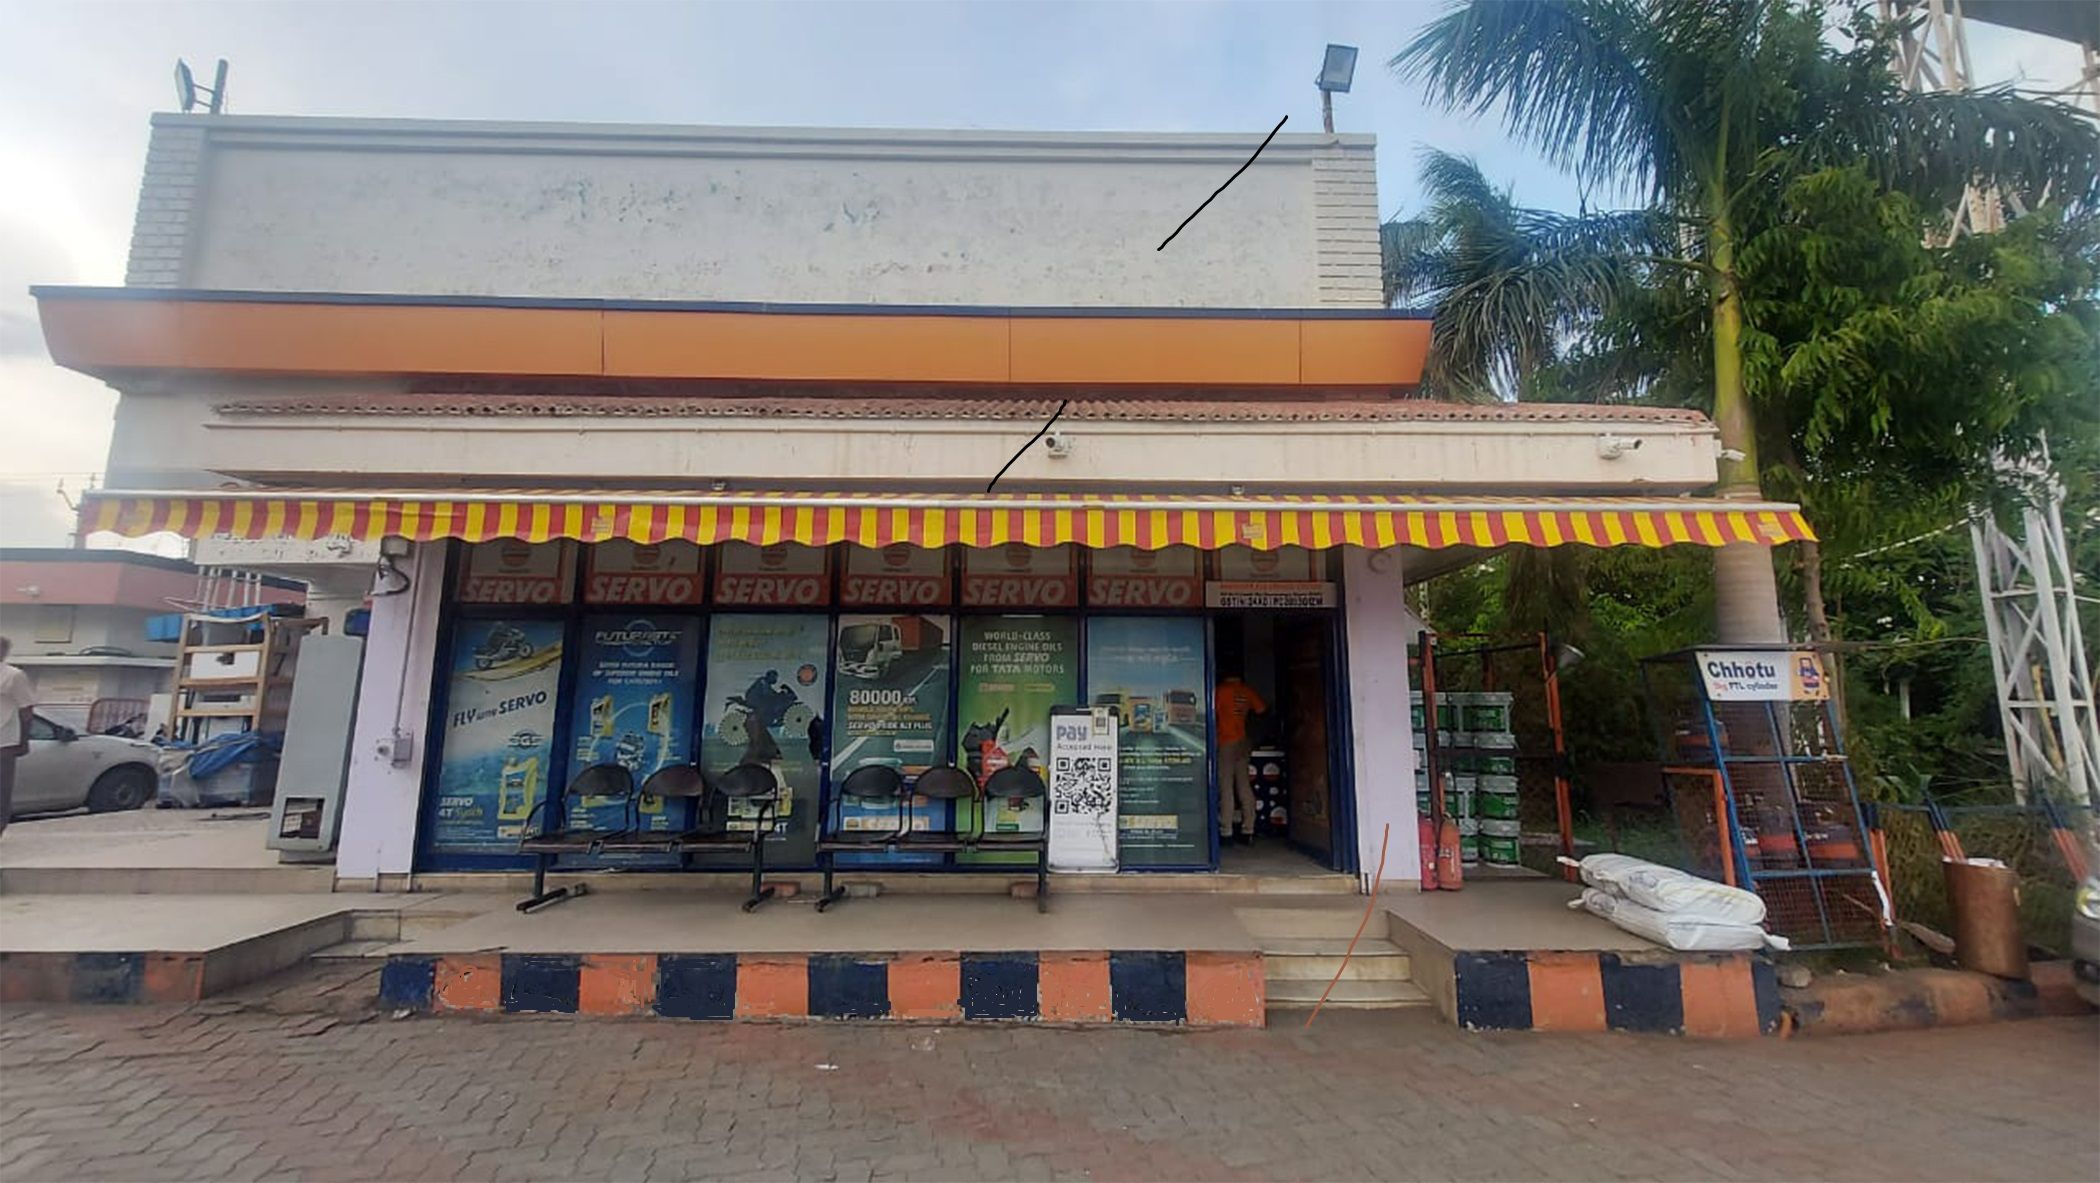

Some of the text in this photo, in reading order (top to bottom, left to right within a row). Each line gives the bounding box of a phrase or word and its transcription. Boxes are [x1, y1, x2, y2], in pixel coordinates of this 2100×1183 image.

[465, 578, 555, 603] SERVO
[590, 576, 693, 601] SERVO
[717, 577, 820, 603] SERVO
[844, 579, 940, 604] SERVO
[965, 579, 1066, 605] SERVO
[1088, 579, 1191, 605] SERVO
[984, 631, 1051, 640] WORLD-CLASS
[972, 642, 1063, 651] DIESEL ENGINE OILS
[983, 652, 1051, 662] FROM SERVO
[970, 664, 1065, 674] FOR TATA MOTORS
[1707, 661, 1775, 678] Chhotu
[849, 690, 901, 705] 80000
[453, 708, 477, 728] FLY
[499, 691, 547, 714] SERVO
[441, 797, 473, 806] SERVO
[439, 808, 453, 817] 4T
